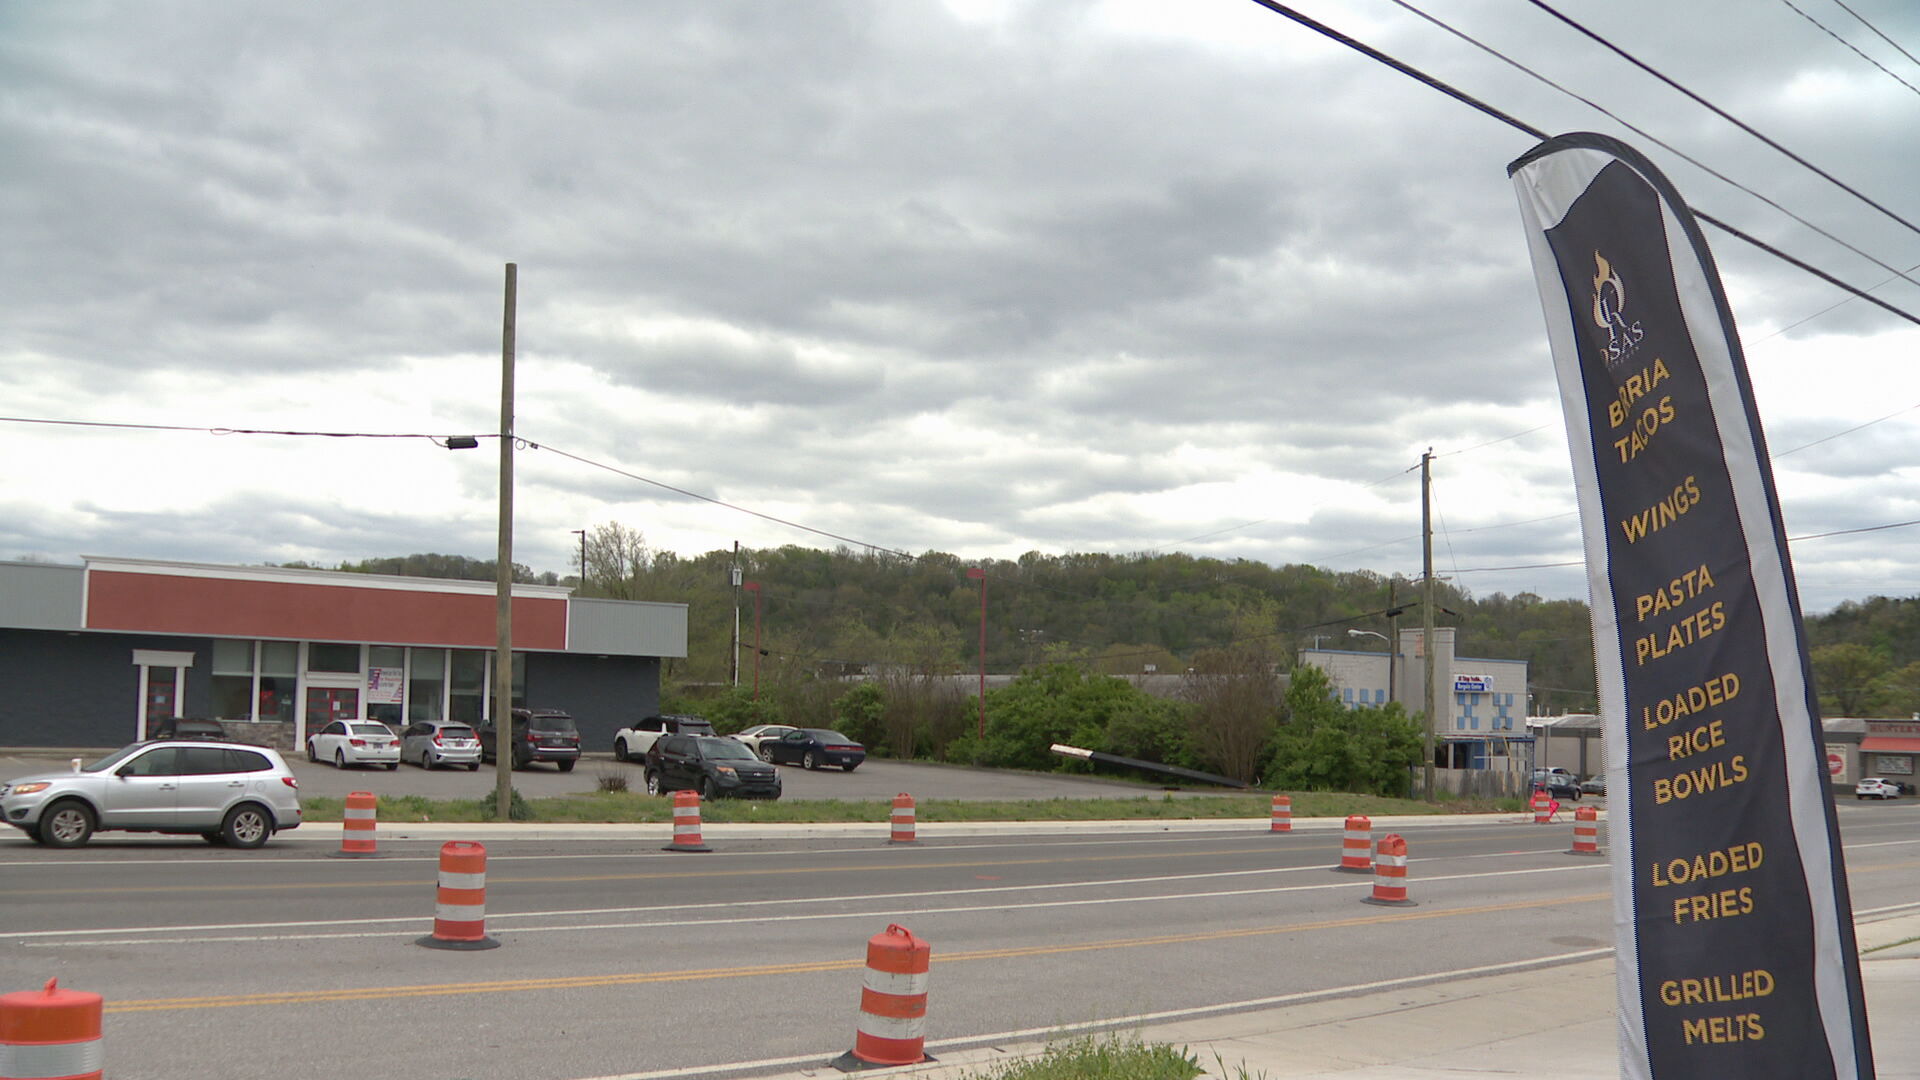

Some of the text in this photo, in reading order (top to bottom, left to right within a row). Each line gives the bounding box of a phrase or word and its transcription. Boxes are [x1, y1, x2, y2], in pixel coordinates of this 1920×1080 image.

[1608, 358, 1671, 429] BRRIA
[1614, 395, 1676, 464] TACOS
[1621, 475, 1701, 544] WINGS
[1635, 563, 1715, 622] PASTA
[1635, 601, 1726, 666] PLATES
[1643, 672, 1740, 731] LOADED
[1668, 719, 1726, 761] RICE
[1654, 755, 1749, 805] BOWLS
[1652, 842, 1764, 887] LOADED
[1673, 887, 1754, 924] FRIES
[1660, 969, 1775, 1006] GRILLED
[1682, 1013, 1765, 1045] MELTS
